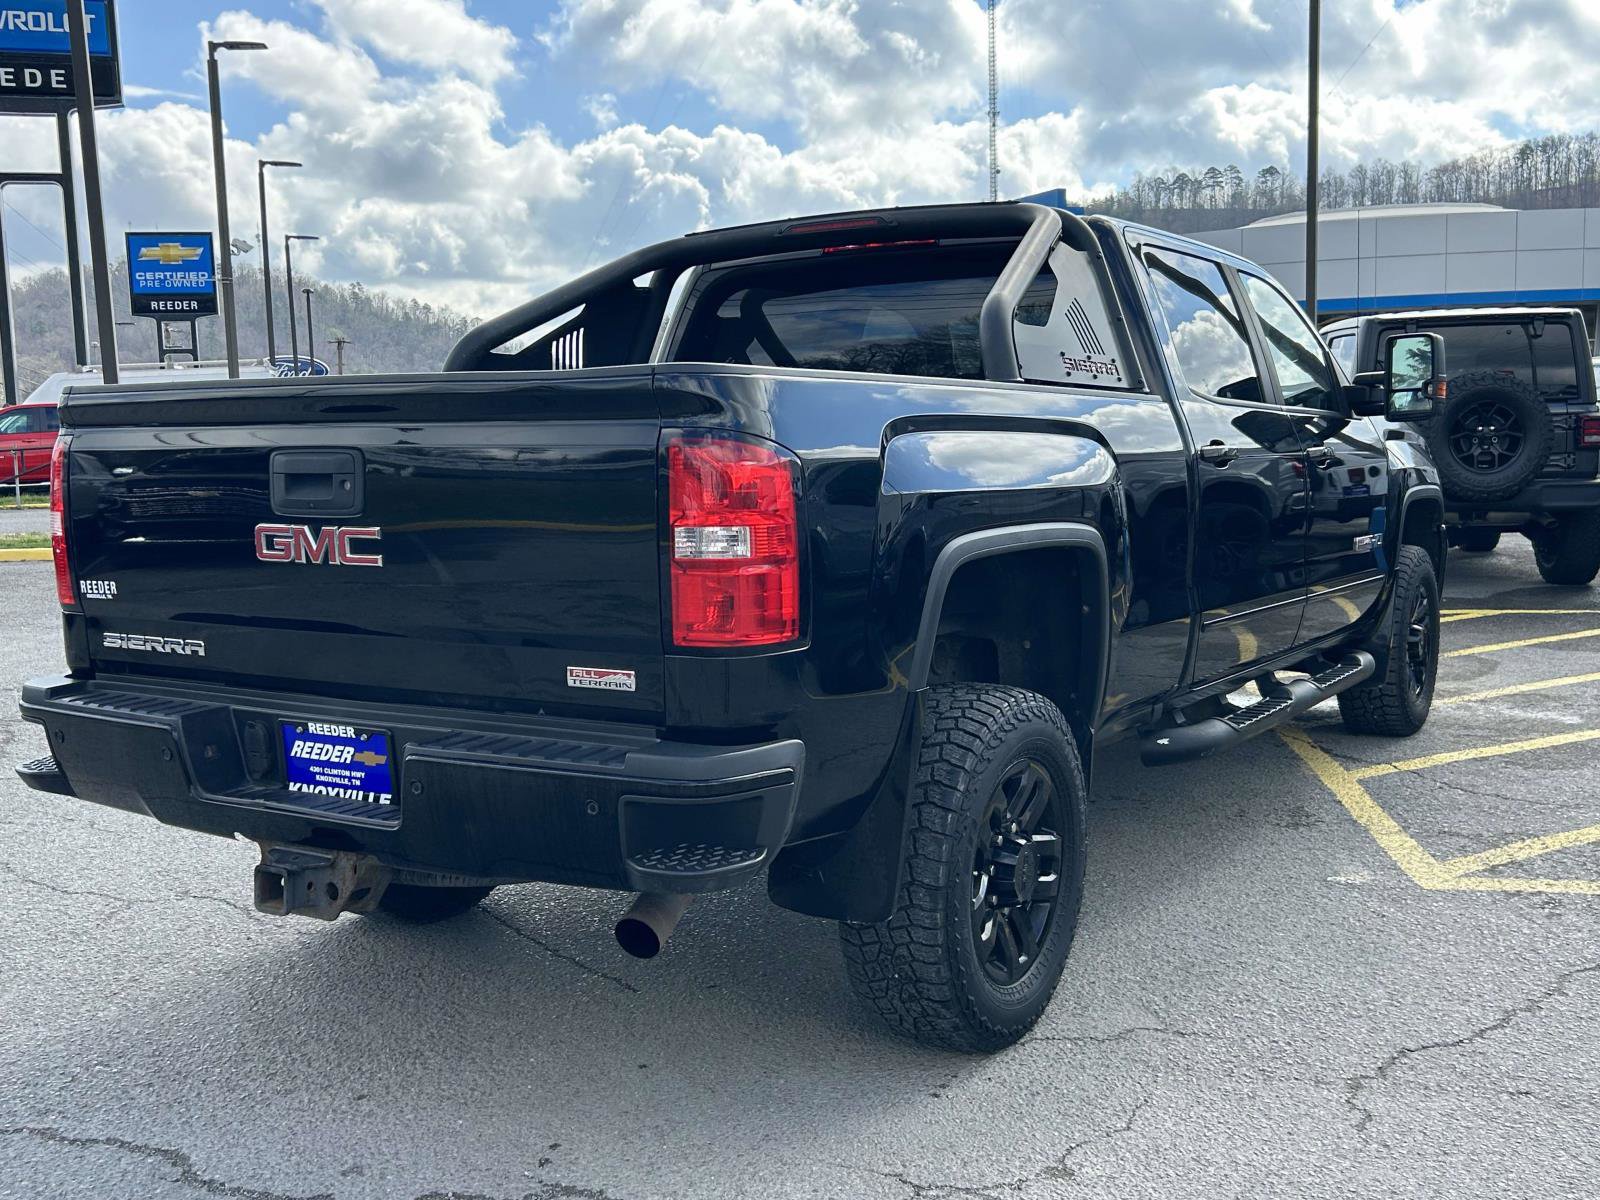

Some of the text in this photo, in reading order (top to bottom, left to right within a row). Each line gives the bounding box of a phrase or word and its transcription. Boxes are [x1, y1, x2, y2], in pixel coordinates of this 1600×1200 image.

[135, 271, 209, 280] CERTIFIED
[139, 280, 206, 288] PRE-OWNED
[151, 301, 198, 310] REEDER
[1062, 357, 1120, 376] SIERRA
[255, 523, 383, 567] GMC
[80, 580, 118, 595] REEDER
[103, 632, 206, 656] SIERRA
[572, 669, 599, 678] ALL
[570, 679, 632, 689] TERRAIN
[307, 722, 356, 739] REEDER
[290, 740, 355, 764] REEDER
[323, 767, 351, 777] CLINTON
[351, 771, 366, 779] HWY
